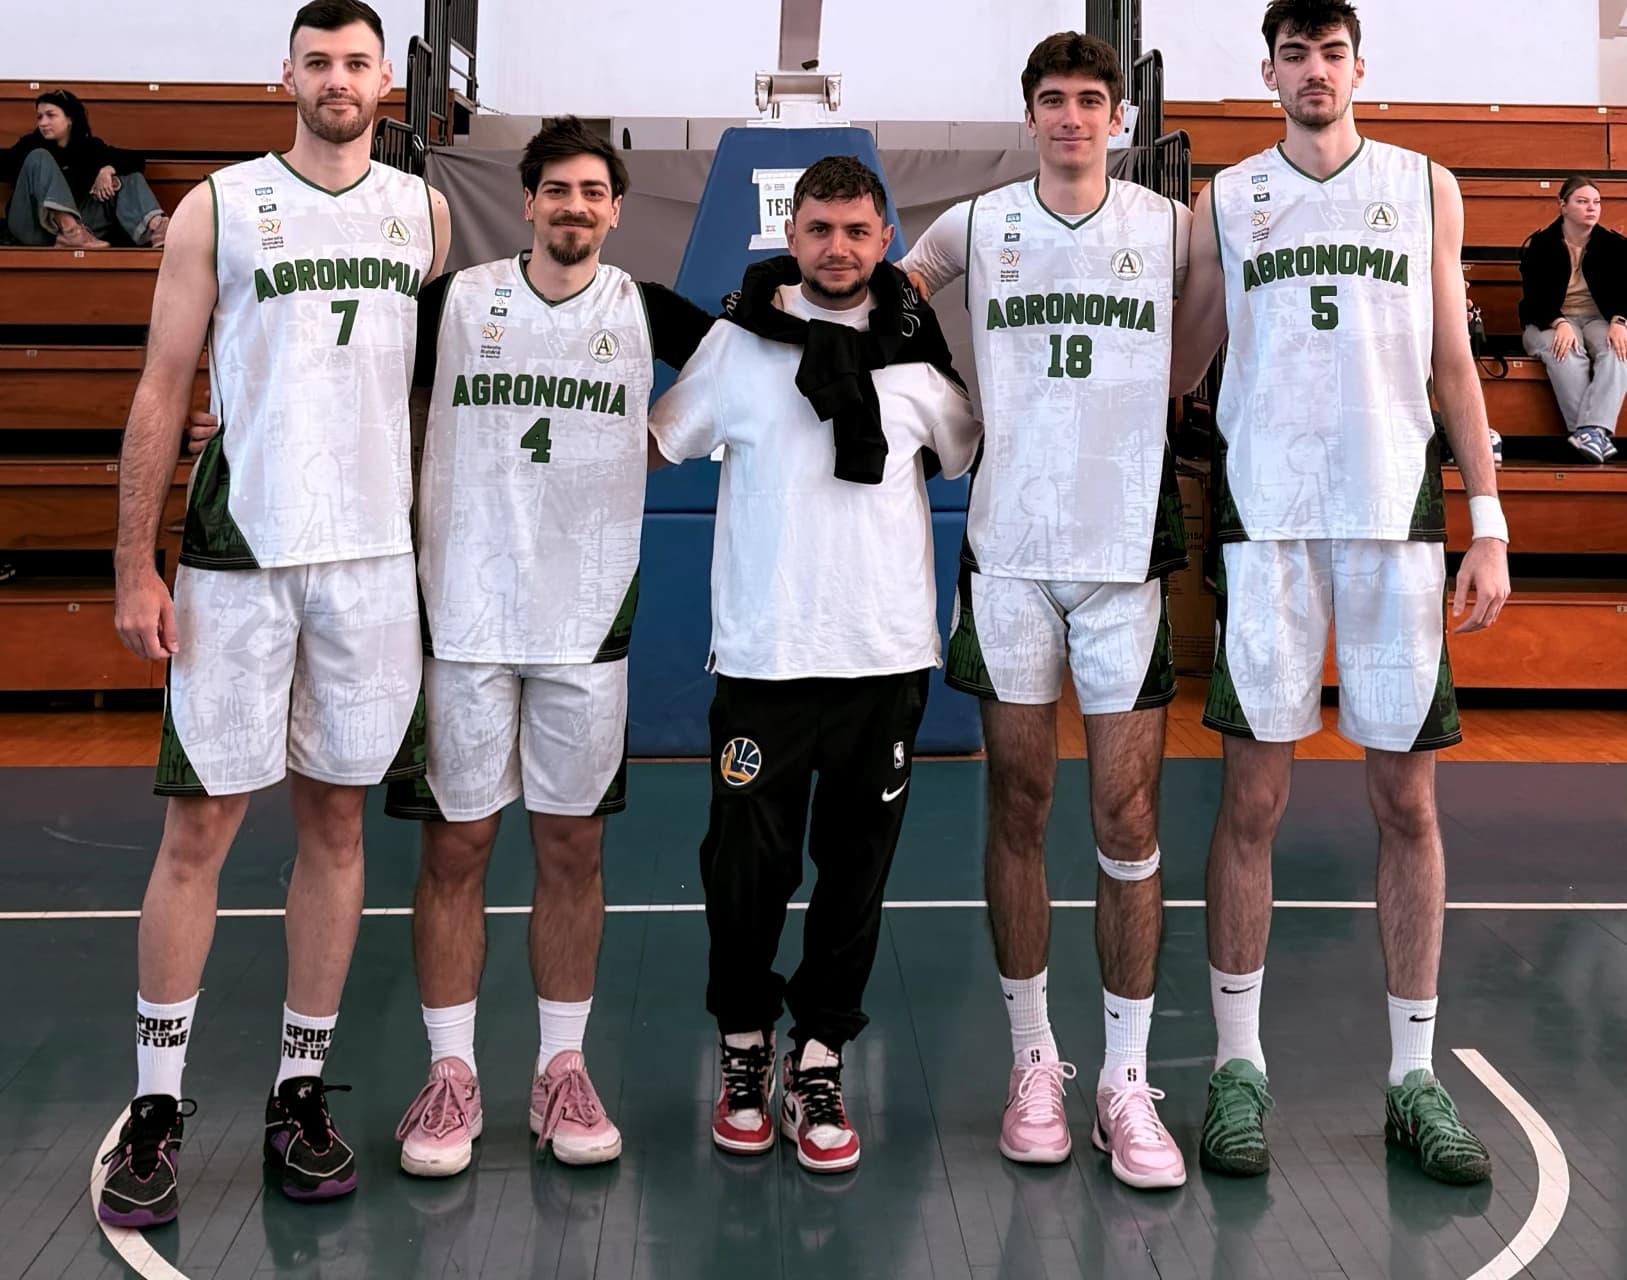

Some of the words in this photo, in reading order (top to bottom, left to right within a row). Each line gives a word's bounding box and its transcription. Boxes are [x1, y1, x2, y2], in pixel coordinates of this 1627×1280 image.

[254, 257, 420, 303] AGRONOMIA
[1243, 244, 1409, 292] AGRONOMIA
[331, 300, 360, 346] 7
[986, 293, 1156, 332] AGRONOMIA
[1310, 285, 1339, 331] 5
[1047, 334, 1093, 378] 18
[452, 373, 626, 416] AGRONOMIA
[520, 417, 552, 463] 4
[136, 1014, 187, 1031] PORT
